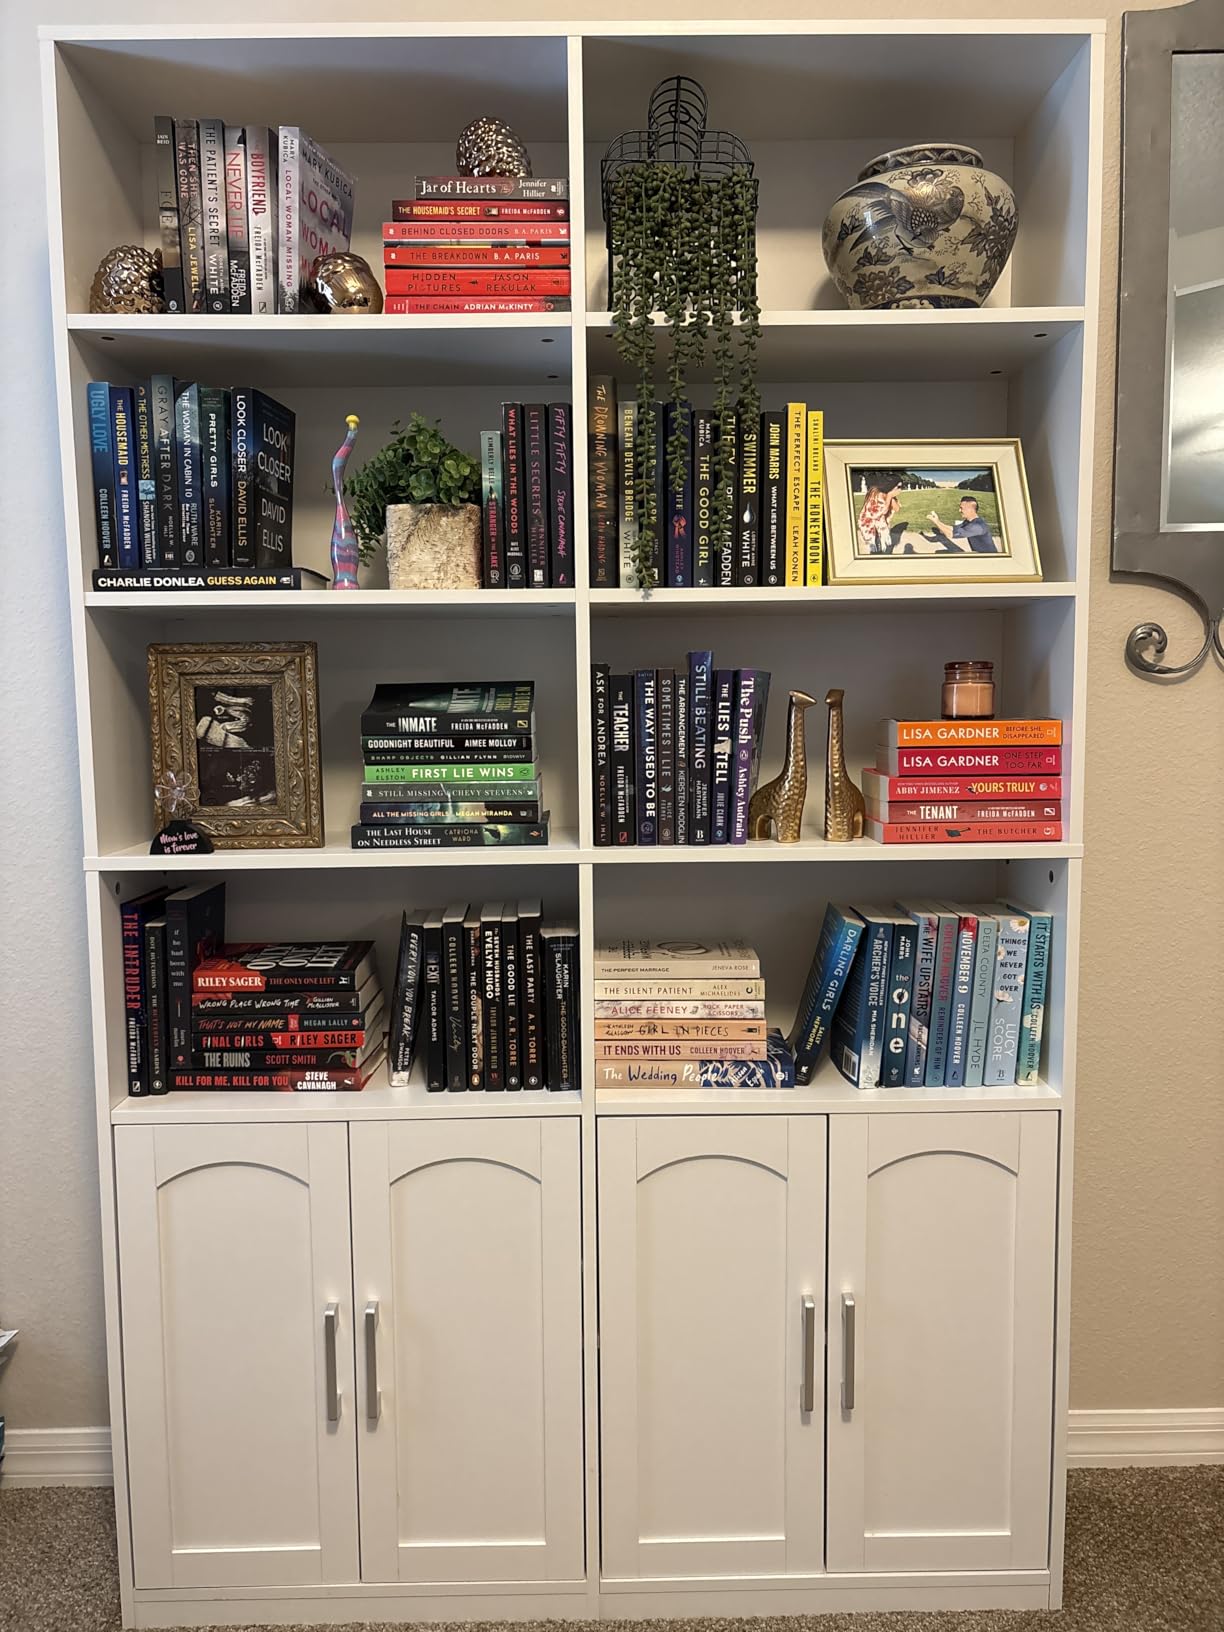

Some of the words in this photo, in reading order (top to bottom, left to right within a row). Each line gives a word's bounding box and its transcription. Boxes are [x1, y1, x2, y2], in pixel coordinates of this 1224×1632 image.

[206, 127, 215, 144] THE
[206, 150, 217, 202] PATIENT'S
[226, 153, 242, 210] NEVER
[251, 154, 266, 216] BOYFRIEND
[421, 181, 436, 195] Jar
[440, 181, 452, 193] of
[456, 181, 496, 193] Hearts
[519, 180, 547, 188] Jennifer
[413, 207, 455, 215] HOUSEMAID'S
[457, 207, 480, 215] SECRET
[208, 209, 220, 246] SECRET
[228, 218, 243, 240] LIE
[90, 391, 107, 420] UGLY
[138, 399, 147, 413] THE
[158, 386, 169, 424] GRAY
[237, 395, 246, 425] LOOK
[139, 415, 148, 440] OTHER
[508, 409, 516, 436] WHAT
[529, 412, 539, 455] LITTLE
[554, 408, 565, 438] FIFTY
[624, 409, 633, 449] BENEATH
[769, 423, 780, 445] JOHN
[93, 423, 108, 453] LOVE
[116, 413, 128, 465] HOUSEMAID
[159, 429, 170, 469] AFTER
[238, 430, 247, 472] CLOSER
[793, 432, 801, 473] PERFECT
[141, 442, 150, 479] MISTRESS
[510, 464, 516, 473] IN
[555, 442, 566, 474] FIFTY
[624, 452, 633, 485] DEVIL'S
[700, 455, 709, 481] THE
[743, 434, 756, 494] SWIMMER
[769, 448, 780, 479] MARRS
[162, 474, 172, 511] DARK
[238, 481, 247, 514] DAVID
[531, 462, 541, 514] SECRETS
[792, 477, 800, 511] ESCAPE
[811, 481, 820, 498] THE
[624, 490, 633, 522] BRIDGE
[699, 487, 709, 529] GOOD
[238, 517, 247, 546] ELLIS
[810, 505, 820, 564] HONEYMOON
[699, 535, 709, 567] GIRL
[769, 560, 776, 570] US
[98, 578, 152, 587] CHARLIE
[154, 577, 205, 586] DONLEA
[207, 577, 242, 585] GUESS
[243, 577, 276, 585] AGAIN
[596, 671, 605, 693] ASK
[645, 680, 654, 704] THE
[695, 665, 706, 702] STILL
[740, 677, 754, 705] The
[398, 717, 437, 732] INMATE
[613, 703, 629, 752] TEACHER
[645, 708, 654, 734] WAY
[739, 708, 752, 744] Push
[904, 729, 933, 739] LISA
[937, 728, 999, 739] GARDNER
[368, 740, 411, 749] GOODNIGHT
[414, 739, 454, 748] BEAUTIFUL
[465, 739, 487, 747] AIMEE
[489, 739, 517, 747] MOLLOY
[597, 719, 606, 766] ANDREA
[695, 707, 706, 769] BEATING
[412, 769, 447, 778] FIRST
[454, 769, 473, 777] LIE
[480, 768, 514, 777] WINS
[645, 746, 655, 778] USED
[646, 782, 655, 798] TO
[736, 766, 748, 798] Ashley
[971, 782, 1004, 793] YOURS
[1007, 782, 1035, 792] TRULY
[646, 802, 655, 817] BE
[736, 799, 746, 838] Audrain
[920, 806, 958, 819] TENANT
[160, 833, 182, 844] Mom's
[184, 832, 198, 840] love
[373, 838, 412, 846] NEEDLESS
[384, 828, 403, 836] LAST
[405, 828, 432, 836] HOUSE
[164, 846, 171, 854] is
[171, 842, 197, 853] forever
[982, 927, 992, 954] DELTA
[1037, 922, 1048, 931] IT
[485, 931, 493, 968] EVELYN
[834, 929, 857, 977] DARLING
[958, 931, 973, 983] NOVEMBER
[1033, 934, 1047, 968] STARTS
[198, 977, 227, 987] RILEY
[229, 977, 262, 987] SAGER
[507, 964, 515, 991] GOOD
[555, 953, 563, 1000] SLAUGHTER
[958, 985, 968, 994] 9
[977, 958, 989, 998] COUNTY
[1031, 971, 1043, 995] WITH
[822, 980, 840, 1012] GIRLS
[1030, 998, 1041, 1010] US
[202, 1036, 230, 1048] FINAL
[235, 1036, 264, 1047] GIRLS
[604, 1046, 612, 1055] IT
[615, 1046, 639, 1055] ENDS
[642, 1046, 666, 1055] WITH
[668, 1046, 681, 1055] US
[992, 1018, 1005, 1061] SCORE
[1004, 1023, 1017, 1058] LUCY
[204, 1055, 221, 1067] THE
[223, 1054, 251, 1067] RUINS
[603, 1068, 623, 1080] The
[628, 1065, 677, 1085] Wedding
[297, 1081, 336, 1090] CAVANAGH
[305, 1071, 329, 1080] STEVE
